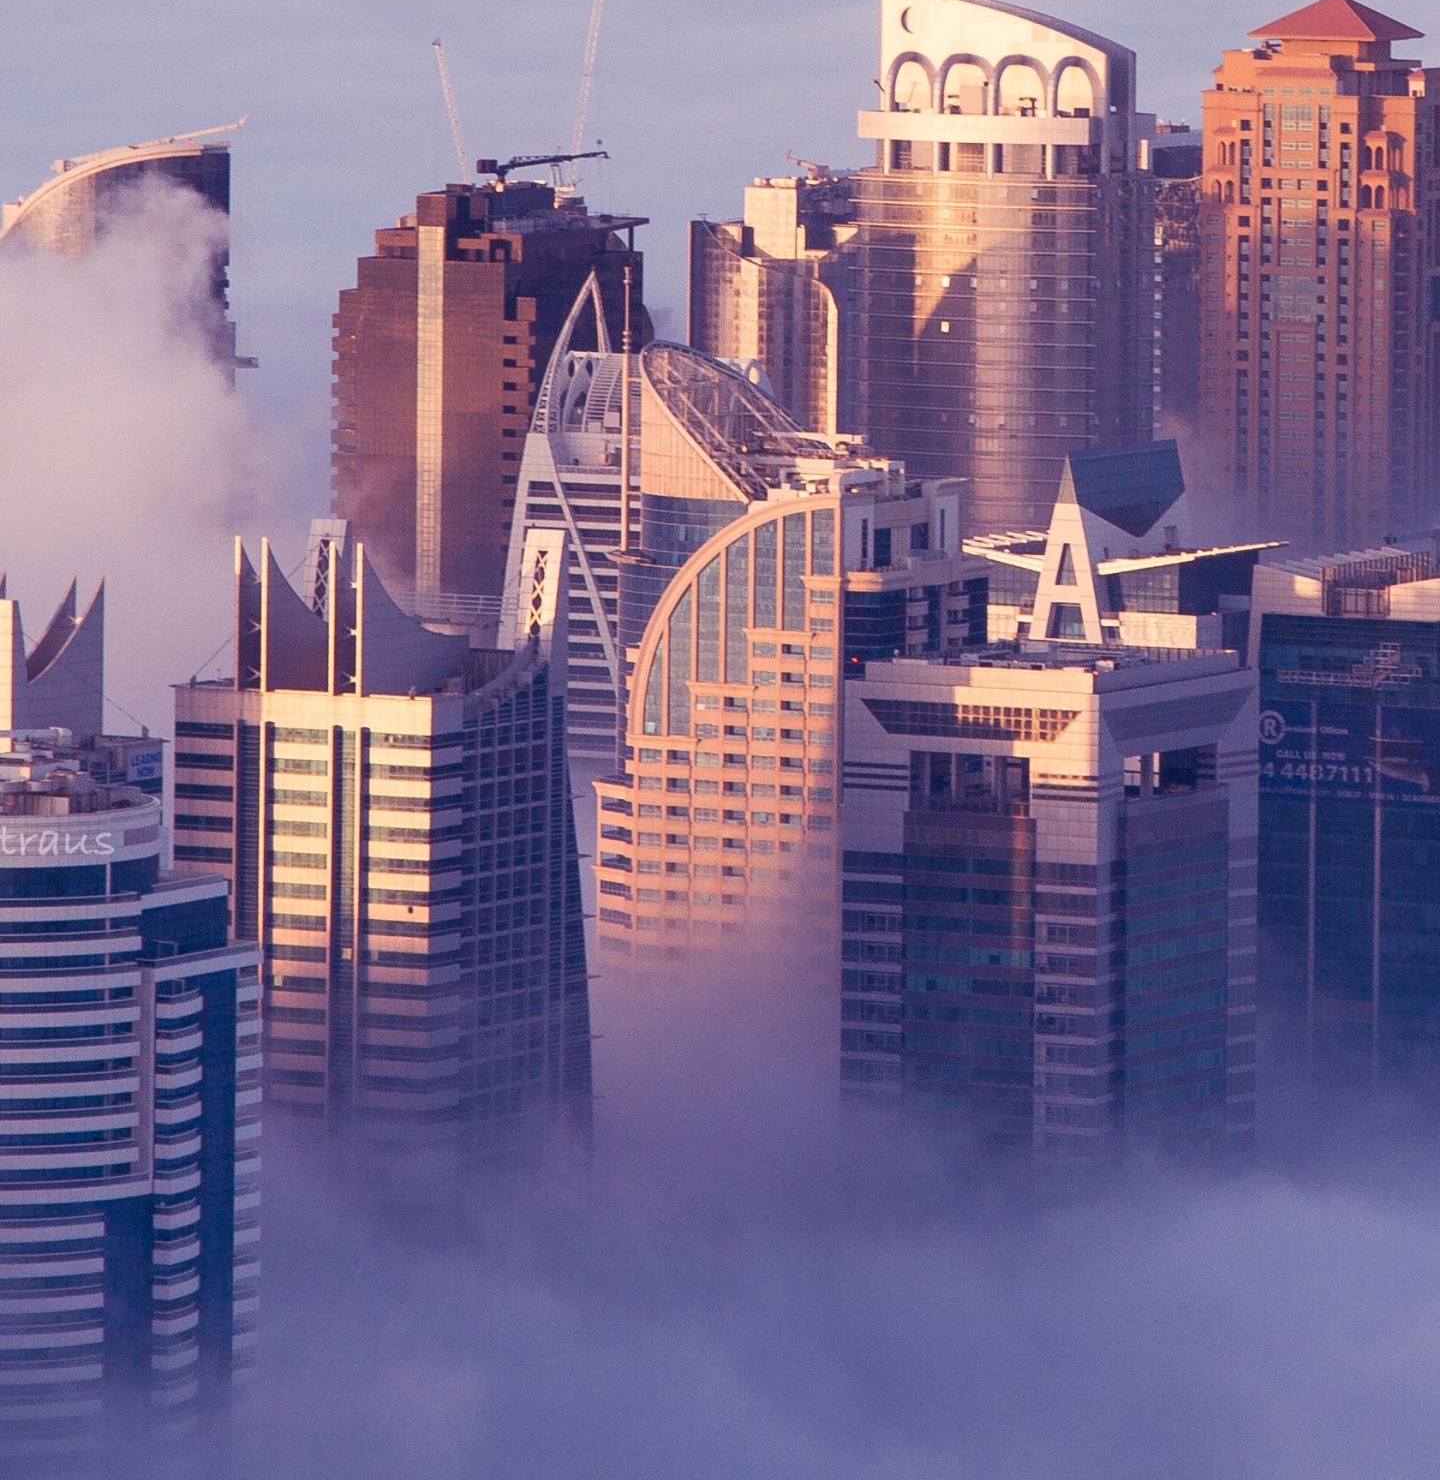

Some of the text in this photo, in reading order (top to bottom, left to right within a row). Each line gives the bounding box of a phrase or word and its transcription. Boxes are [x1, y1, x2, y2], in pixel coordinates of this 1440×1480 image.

[1276, 750, 1345, 761] CALL US NOW
[1280, 763, 1372, 783] 4487111
[0, 825, 115, 857] traus
